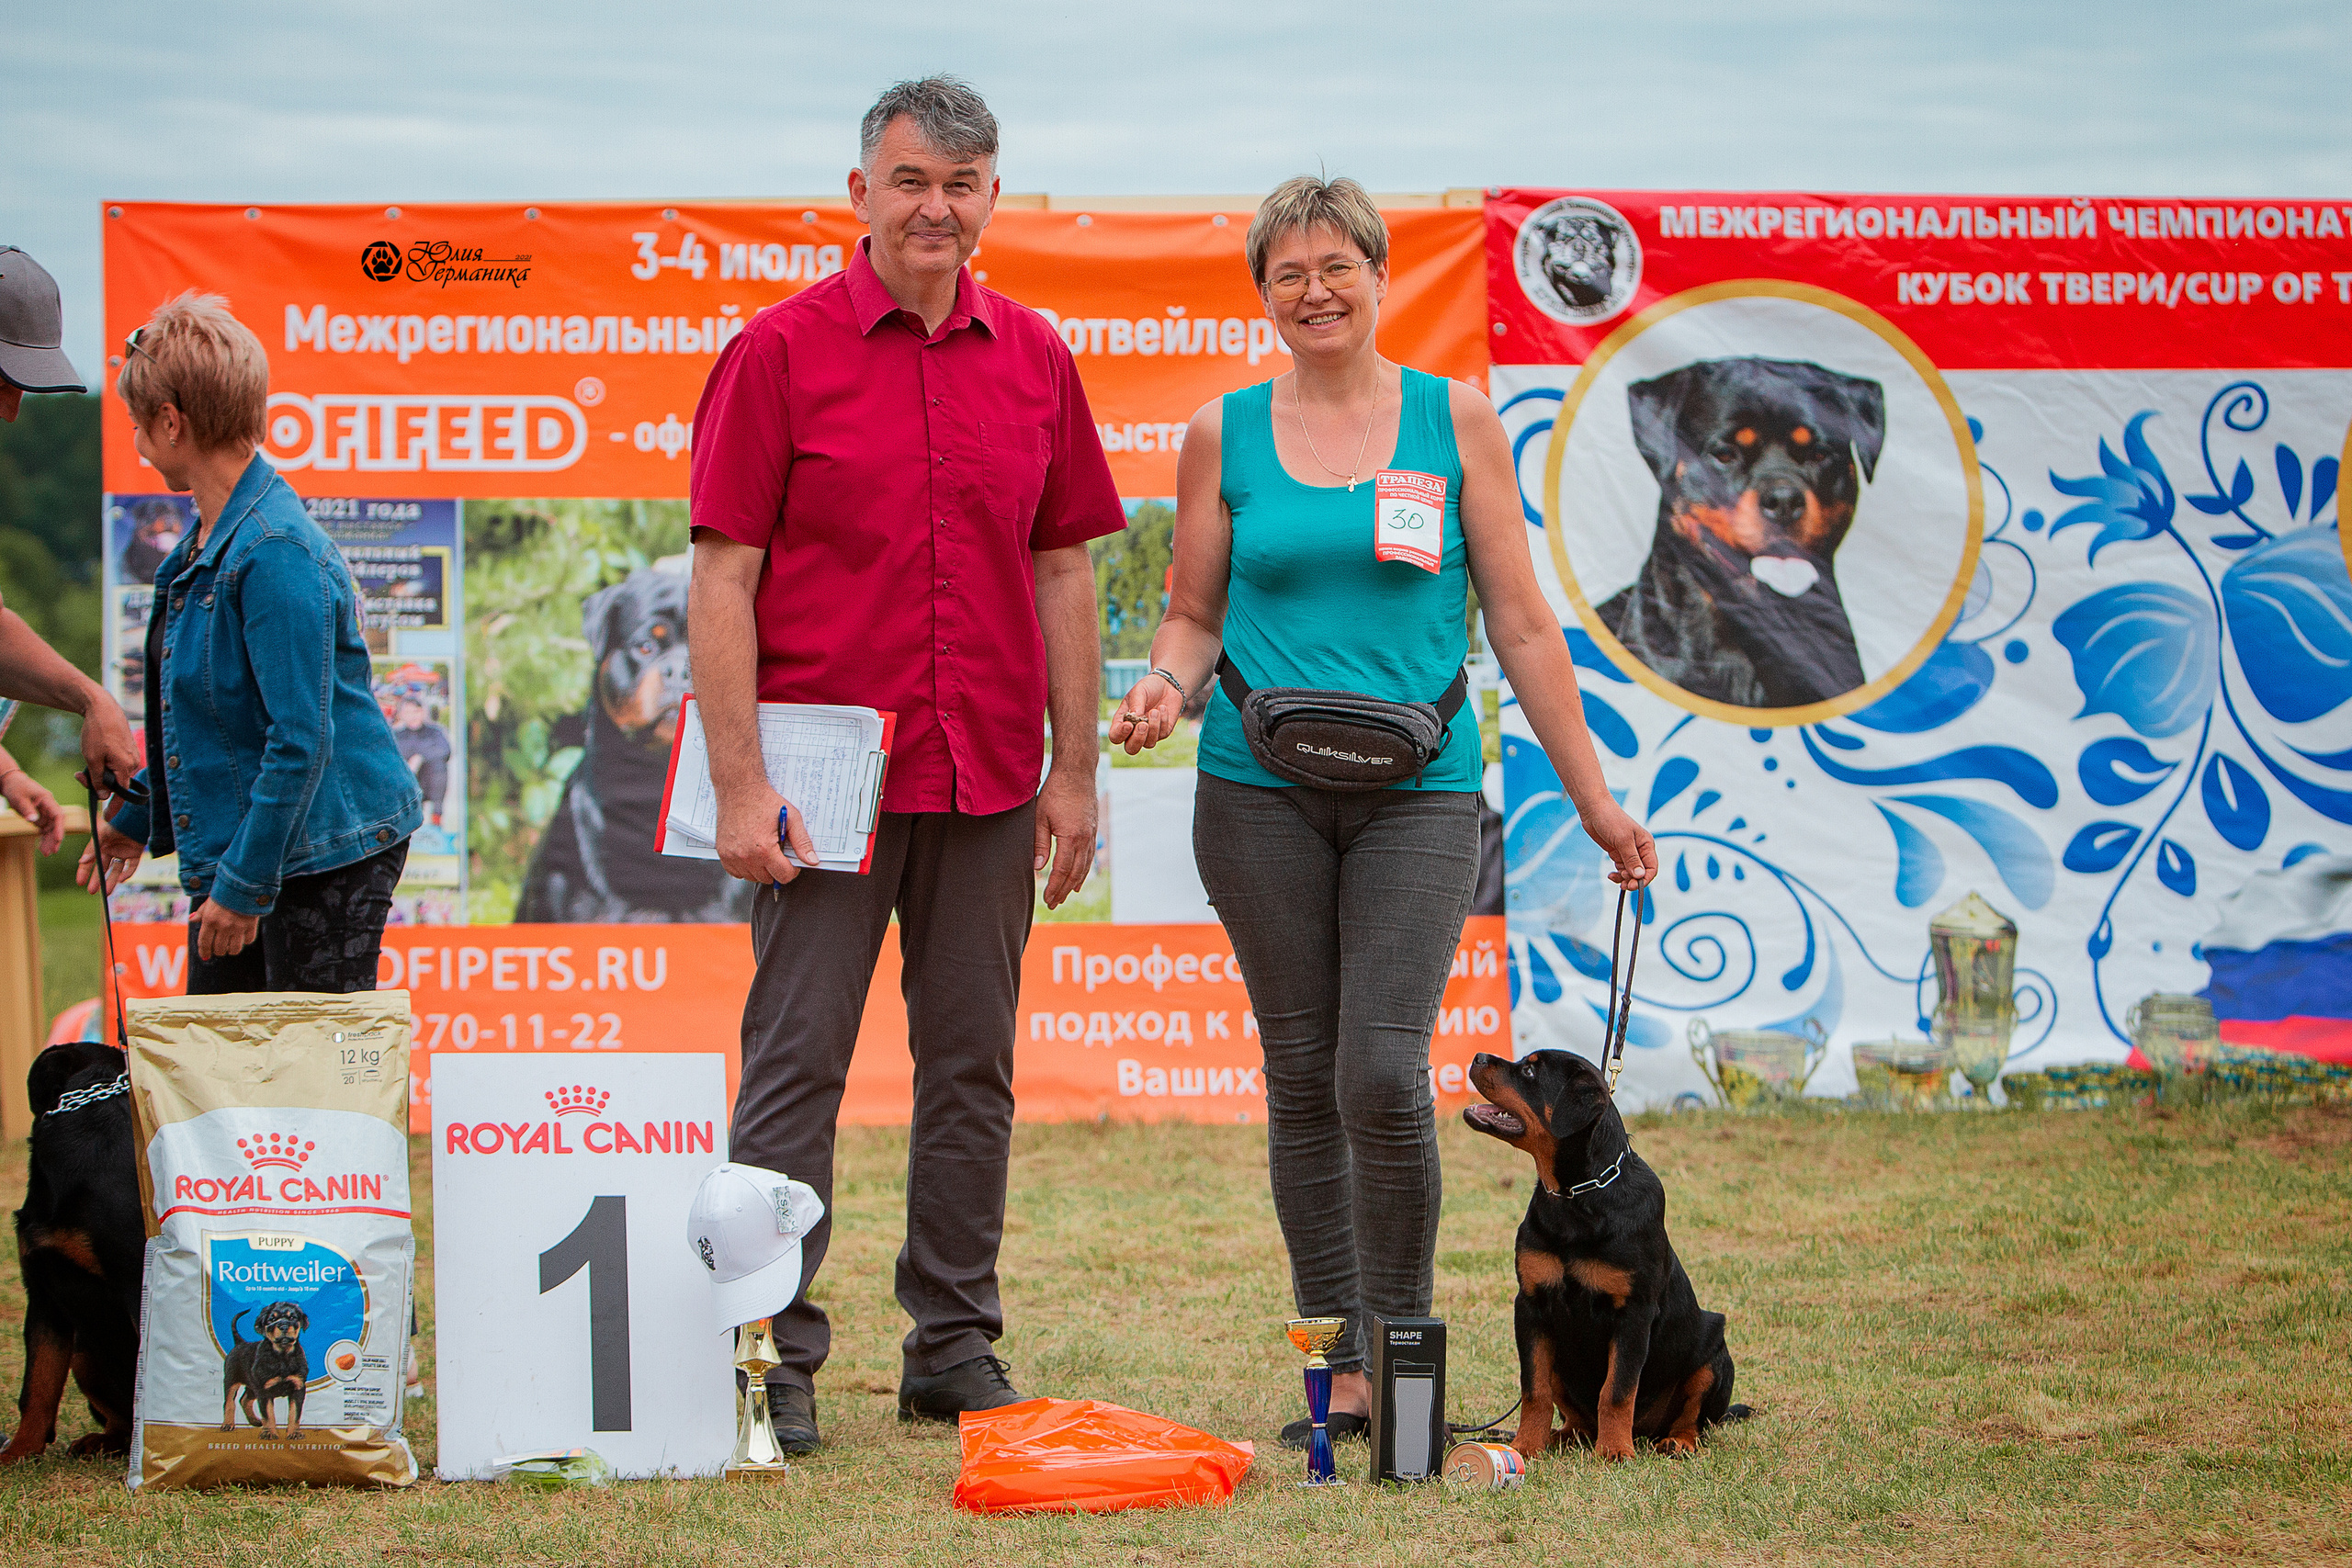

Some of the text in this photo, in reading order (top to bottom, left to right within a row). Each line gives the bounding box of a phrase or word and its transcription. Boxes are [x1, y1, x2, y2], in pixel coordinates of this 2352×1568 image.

[1659, 197, 2098, 239] МЕЖРЕГИОНАЛЬНЫЙ
[630, 231, 843, 281] 3-4 июля
[1896, 272, 2032, 305] КУБОК
[2039, 271, 2264, 309] ТВЕРИ/CUP
[2271, 271, 2323, 305] OF
[284, 304, 745, 364] Межрегиональный
[255, 392, 588, 472] OFIFEED
[1380, 475, 1442, 493] ТРАПЕЗА
[1388, 509, 1424, 529] 30
[1030, 1010, 1193, 1049] подход
[1205, 1010, 1230, 1040] к
[340, 1048, 379, 1066] 12 kg
[343, 1076, 355, 1085] 20
[1117, 1059, 1260, 1097] Ваших
[447, 1121, 713, 1154] ROYAL CANIN
[175, 1174, 381, 1202] ROYAL CANIN
[258, 1236, 294, 1247] PUPPY
[219, 1259, 346, 1282] Rottweiler
[538, 1195, 632, 1432] 1
[1389, 1331, 1422, 1339] SHAPE
